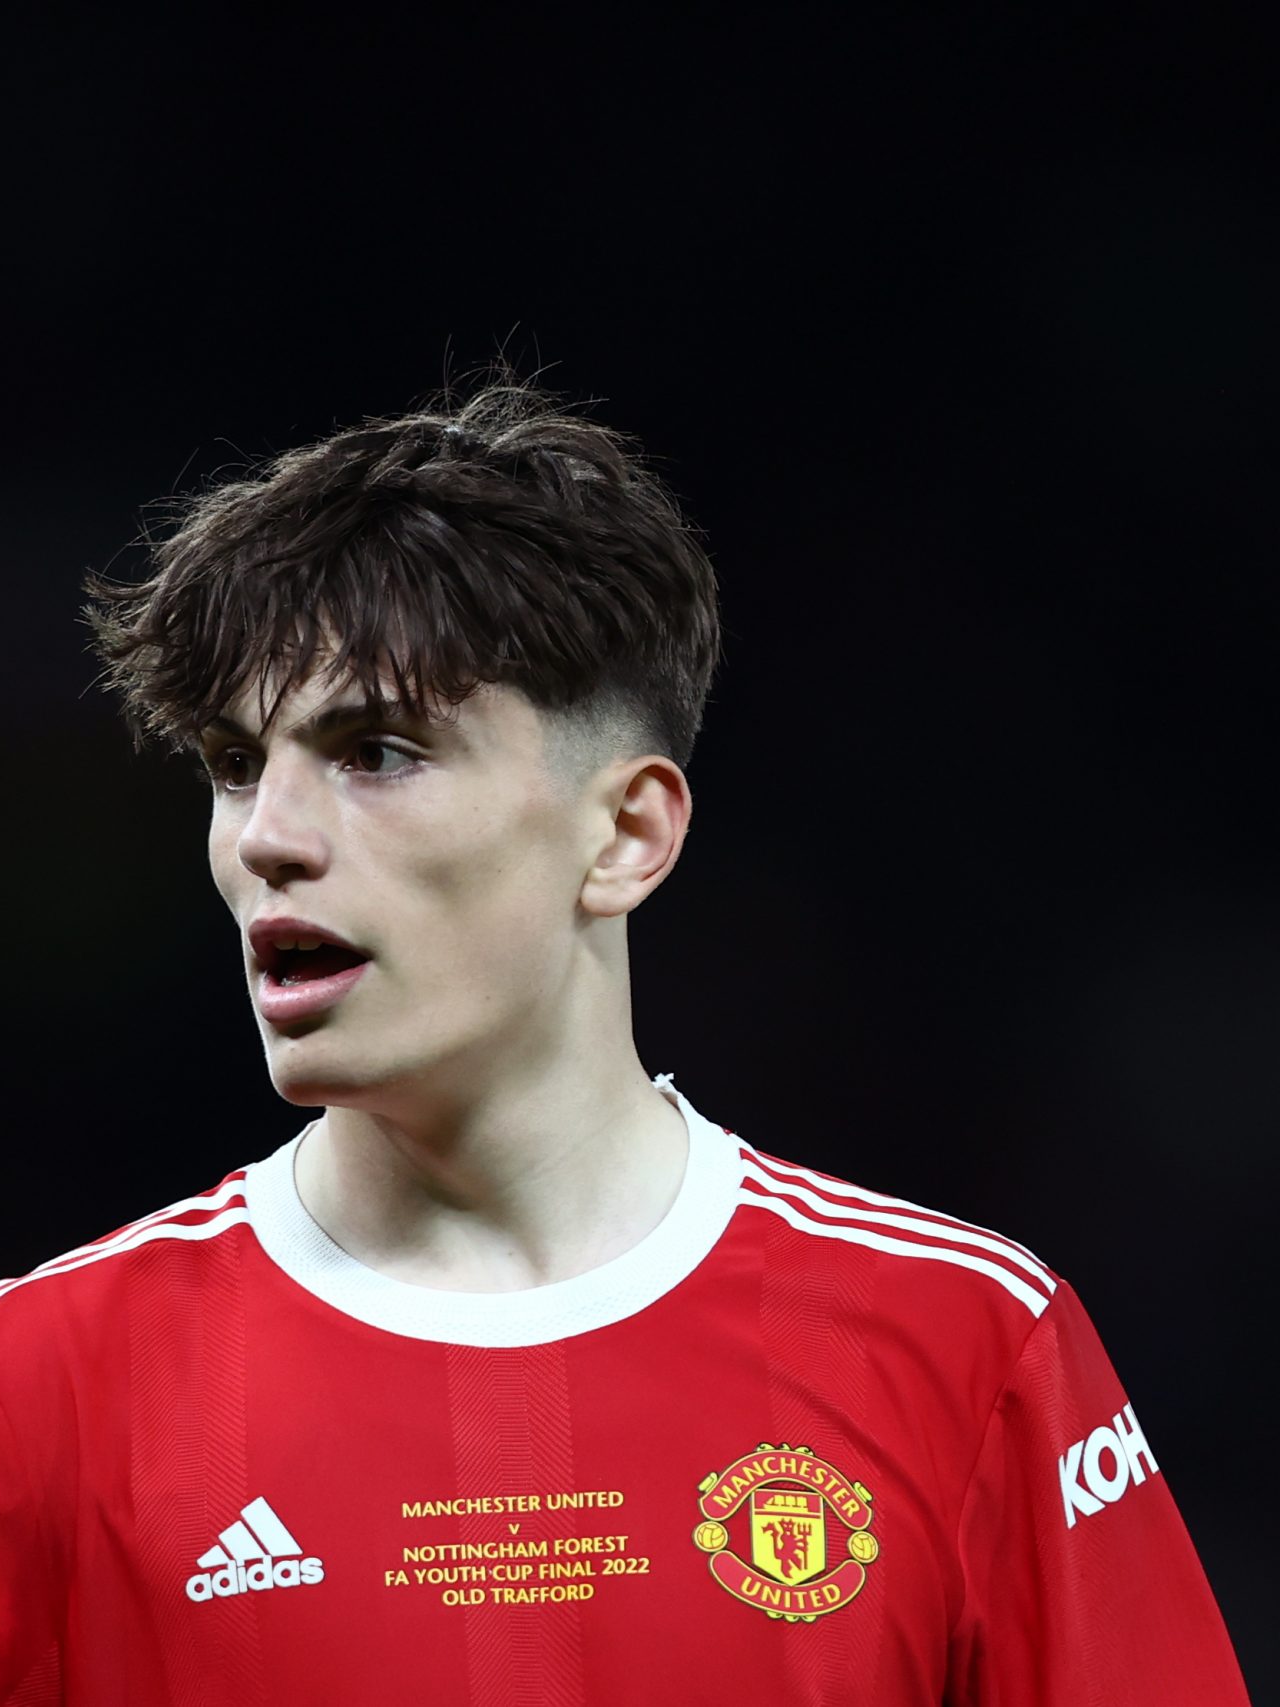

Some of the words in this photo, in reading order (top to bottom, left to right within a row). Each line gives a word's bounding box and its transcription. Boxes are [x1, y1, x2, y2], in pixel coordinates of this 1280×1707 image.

[712, 1456, 861, 1518] MANCHESTER
[401, 1496, 542, 1518] MANCHESTER
[546, 1491, 624, 1510] UNITED
[403, 1541, 548, 1563] NOTTINGHAM
[554, 1535, 629, 1555] FOREST
[185, 1554, 325, 1602] adidas
[384, 1570, 410, 1587] FA
[413, 1565, 486, 1584] YOUTH
[492, 1564, 533, 1581] CUP
[538, 1560, 597, 1580] FINAL
[601, 1557, 650, 1575] 2022
[442, 1588, 486, 1606] OLD
[489, 1583, 595, 1604] TRAFFORD
[740, 1576, 841, 1609] UNITED
